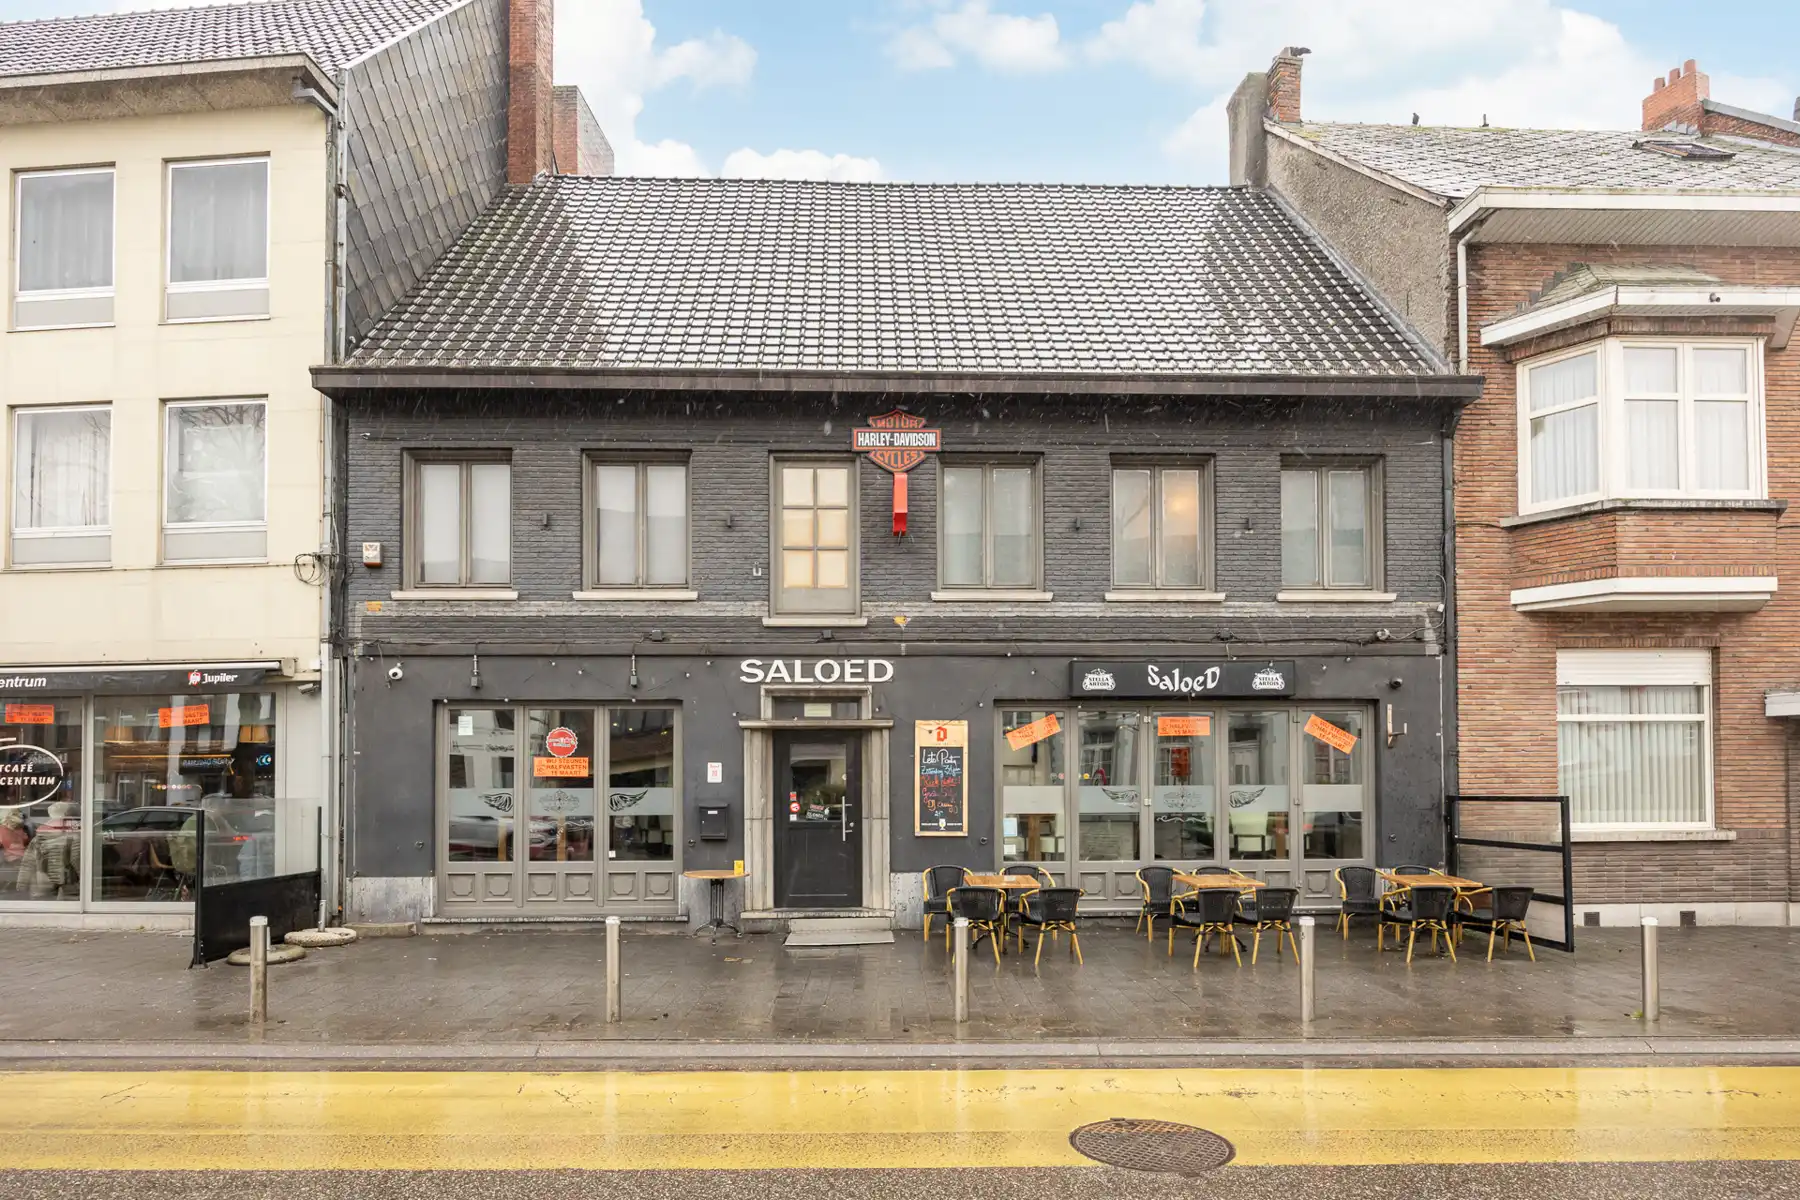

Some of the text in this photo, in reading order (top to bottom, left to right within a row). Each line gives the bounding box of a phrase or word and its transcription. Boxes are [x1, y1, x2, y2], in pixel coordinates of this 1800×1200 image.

[876, 414, 919, 428] MOTOR
[857, 432, 936, 447] HARLEY-DAVIDSON
[874, 450, 918, 468] CYCLES
[740, 659, 894, 683] SALOED
[202, 673, 239, 684] Jupiler
[0, 776, 55, 786] CENTRUM
